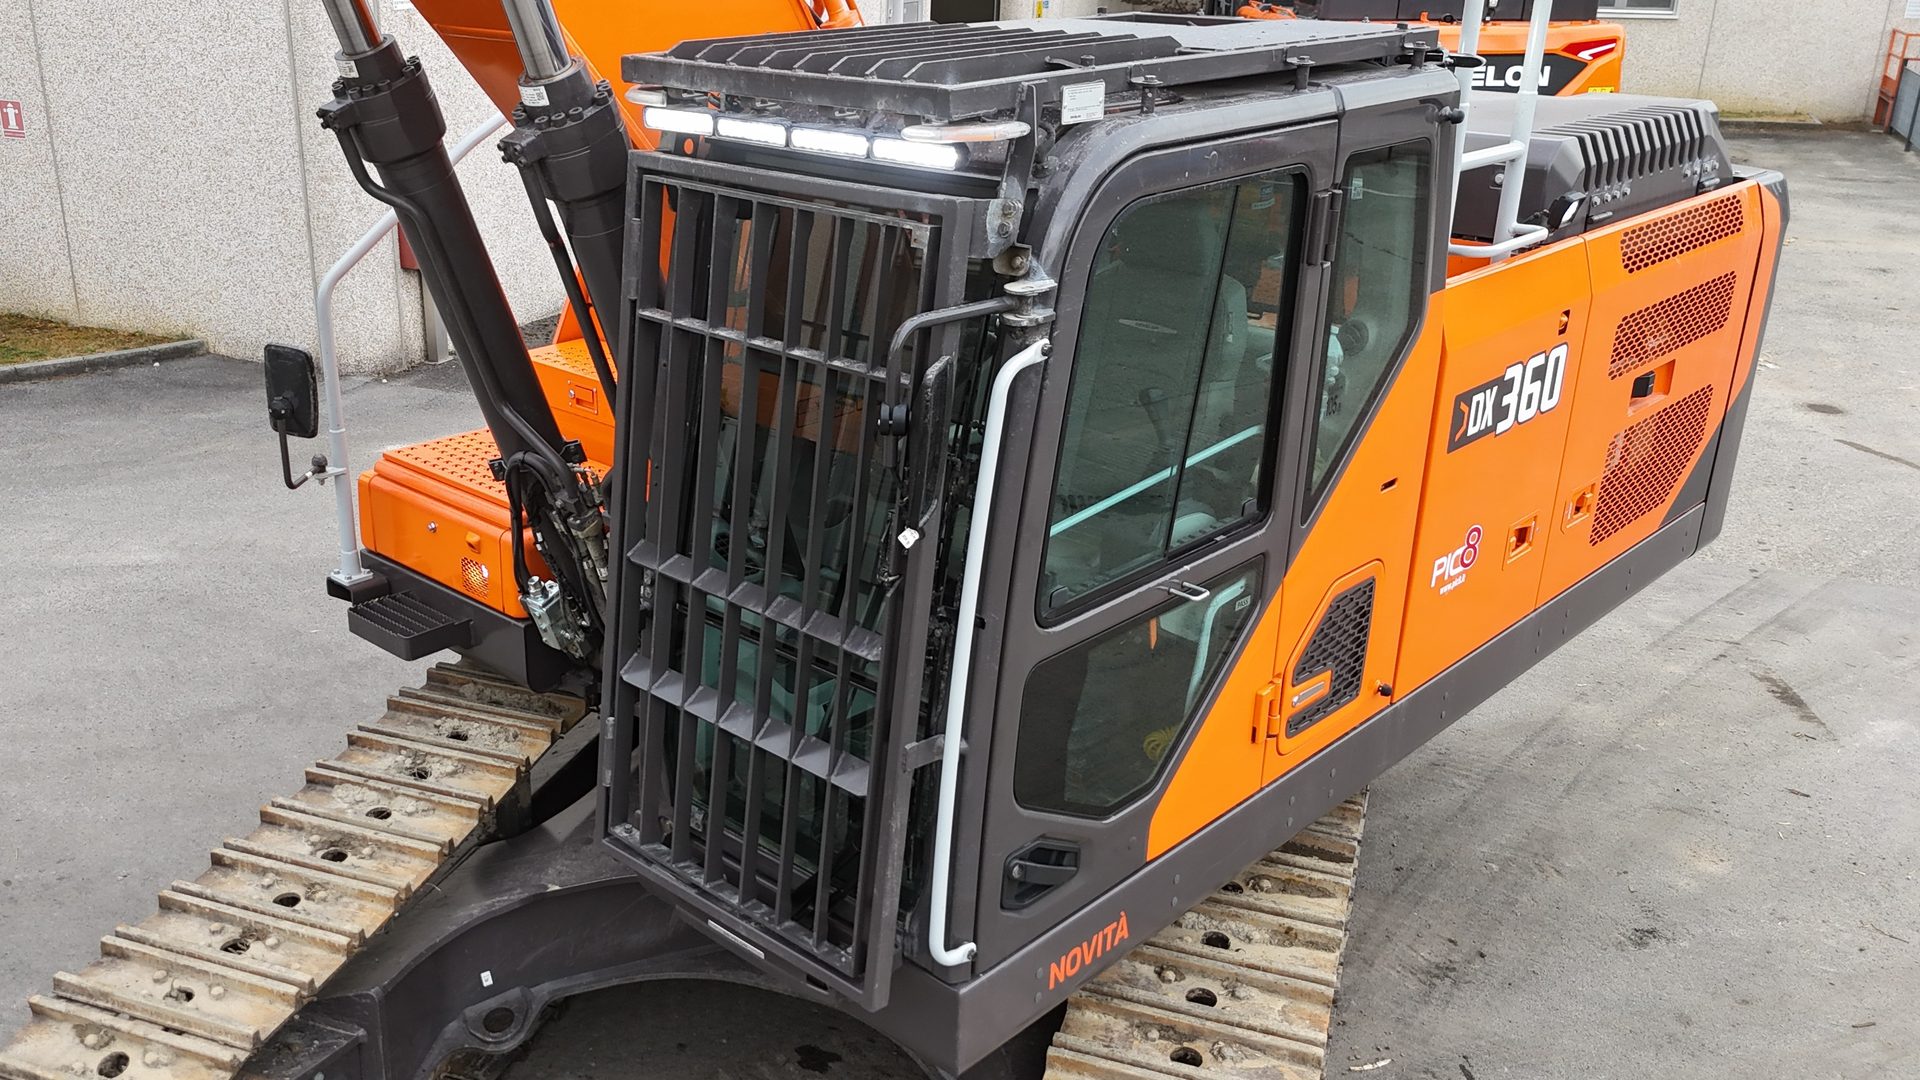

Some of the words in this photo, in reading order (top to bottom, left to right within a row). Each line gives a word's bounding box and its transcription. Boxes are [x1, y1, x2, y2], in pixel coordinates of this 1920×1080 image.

[1467, 385, 1498, 437] DX
[1495, 343, 1568, 436] 360
[1430, 524, 1483, 588] PIC8
[1048, 911, 1129, 991] NOVITÀ
